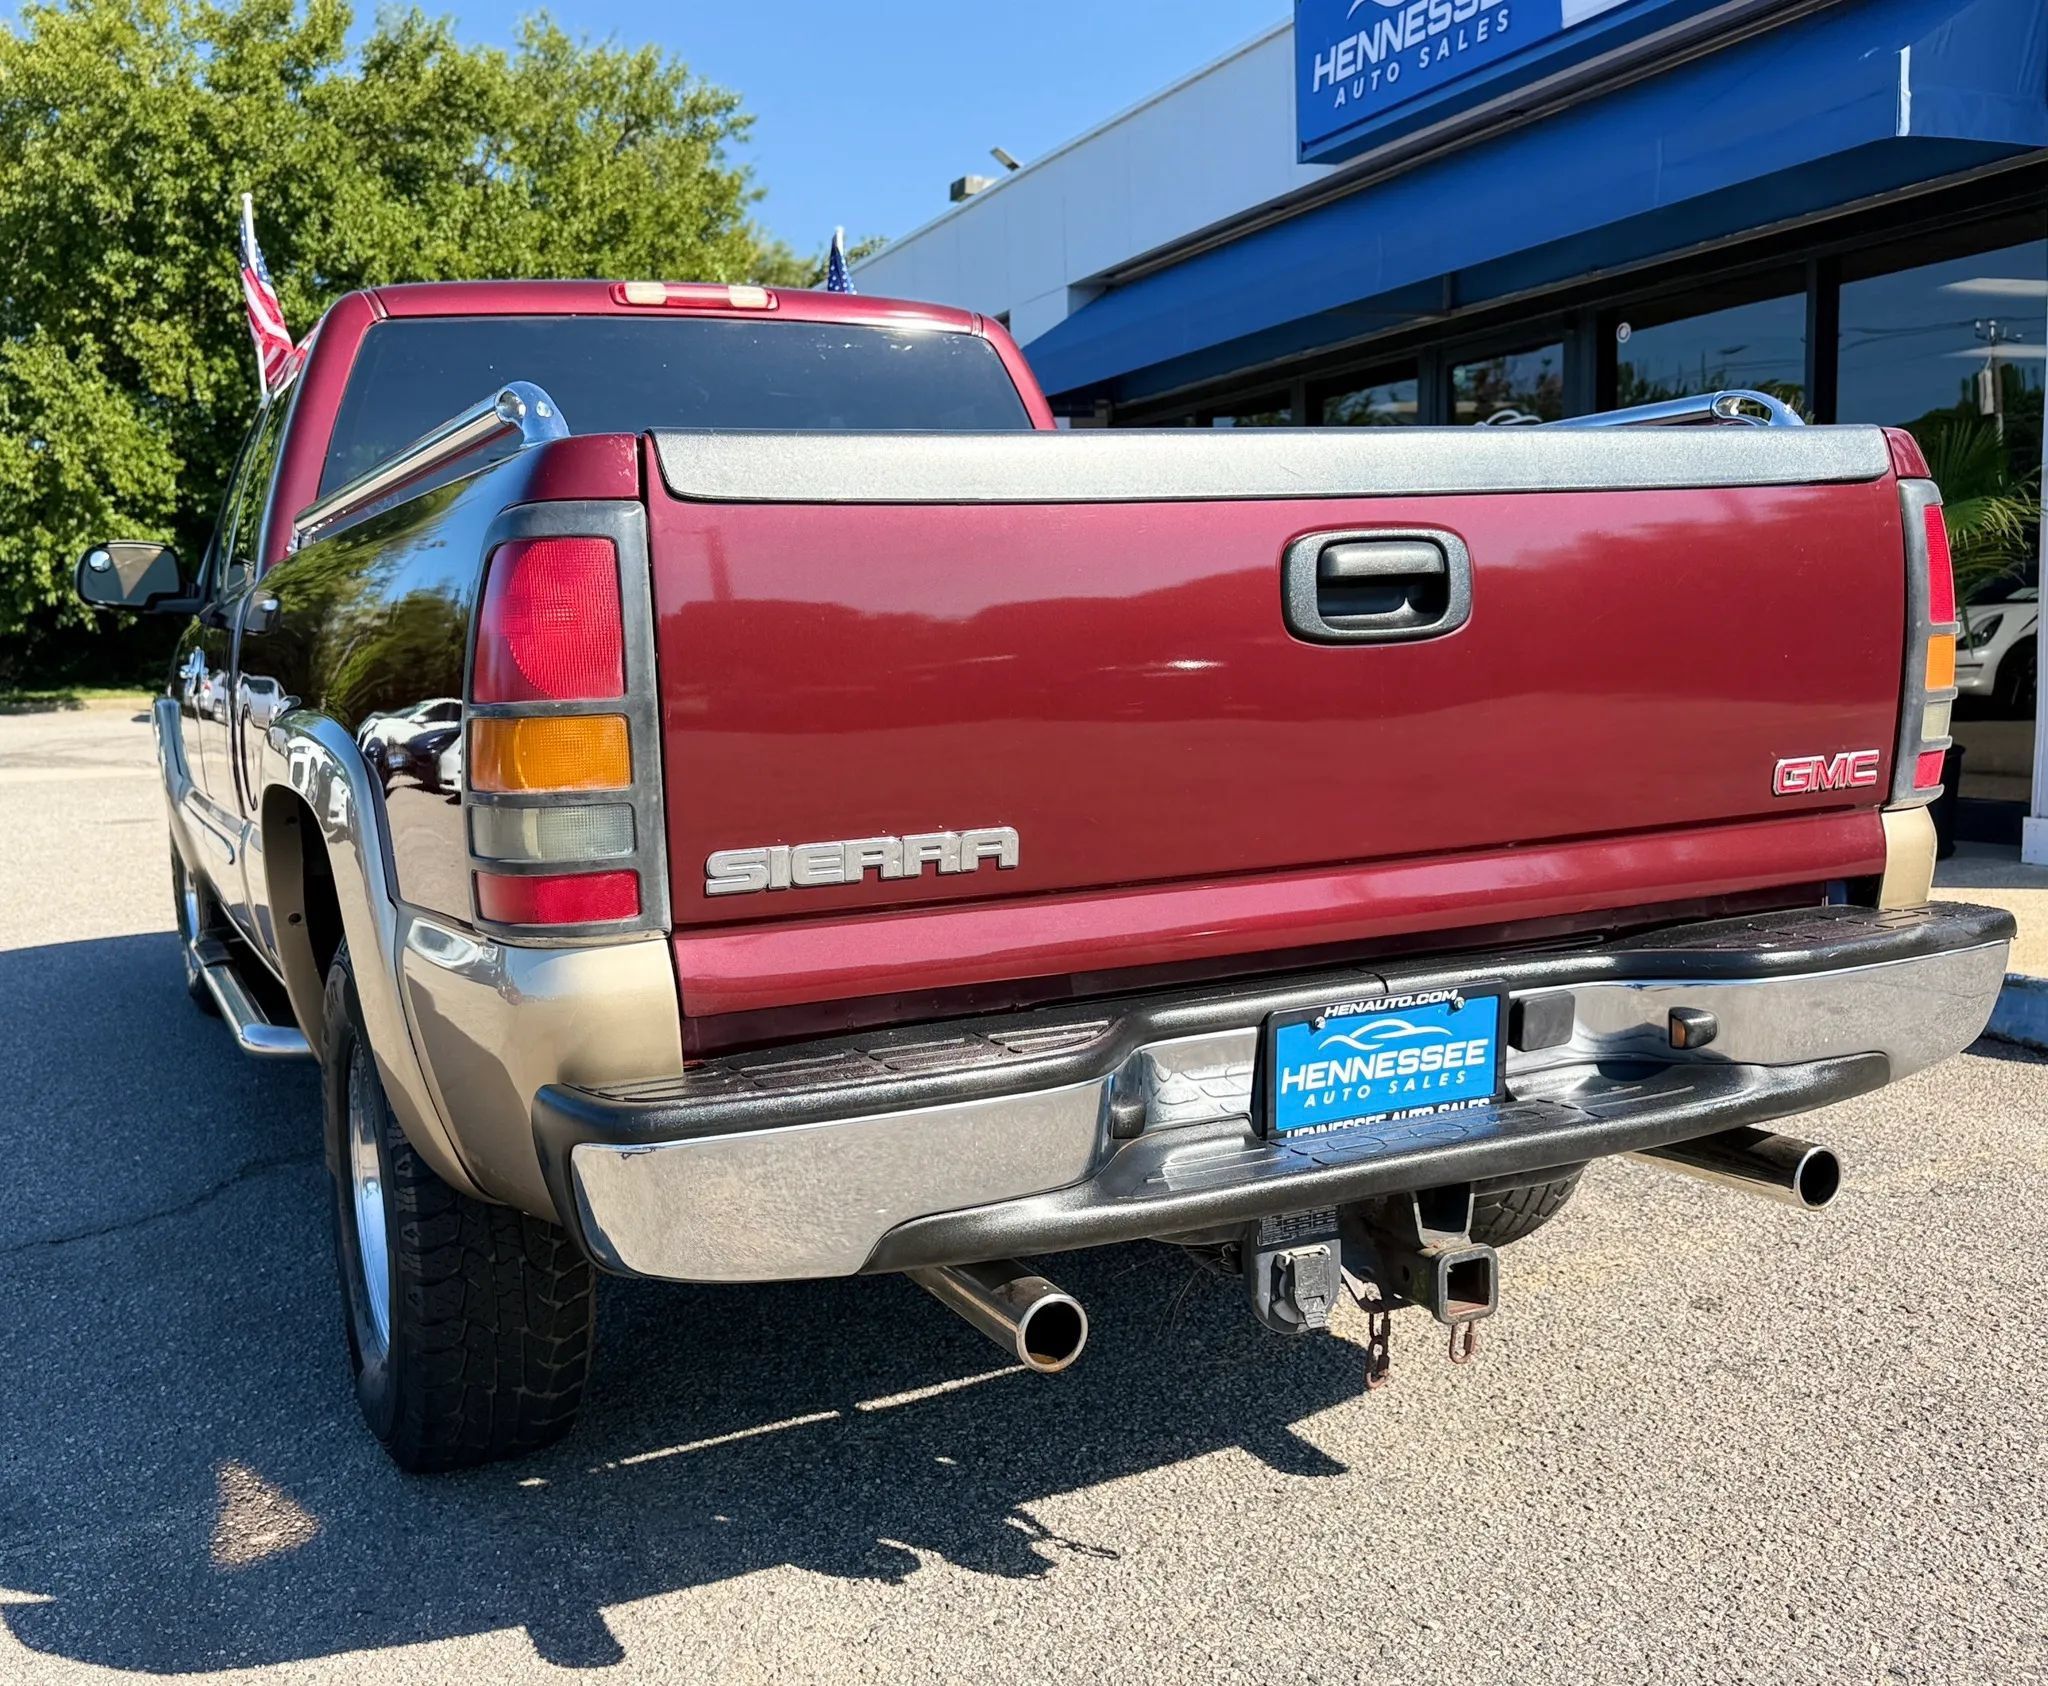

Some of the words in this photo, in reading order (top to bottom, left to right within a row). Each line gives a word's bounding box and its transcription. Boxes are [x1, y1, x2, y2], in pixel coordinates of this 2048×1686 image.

[1334, 62, 1400, 108] AUTO
[1419, 9, 1509, 69] SALES
[1772, 749, 1880, 796] GMC
[706, 826, 1019, 895] SIERRA
[1324, 989, 1458, 1018] HENAUTO.COM
[1281, 1038, 1489, 1094] HENNESSEE
[1304, 1086, 1371, 1108] AUTO
[1389, 1070, 1466, 1094] SALES
